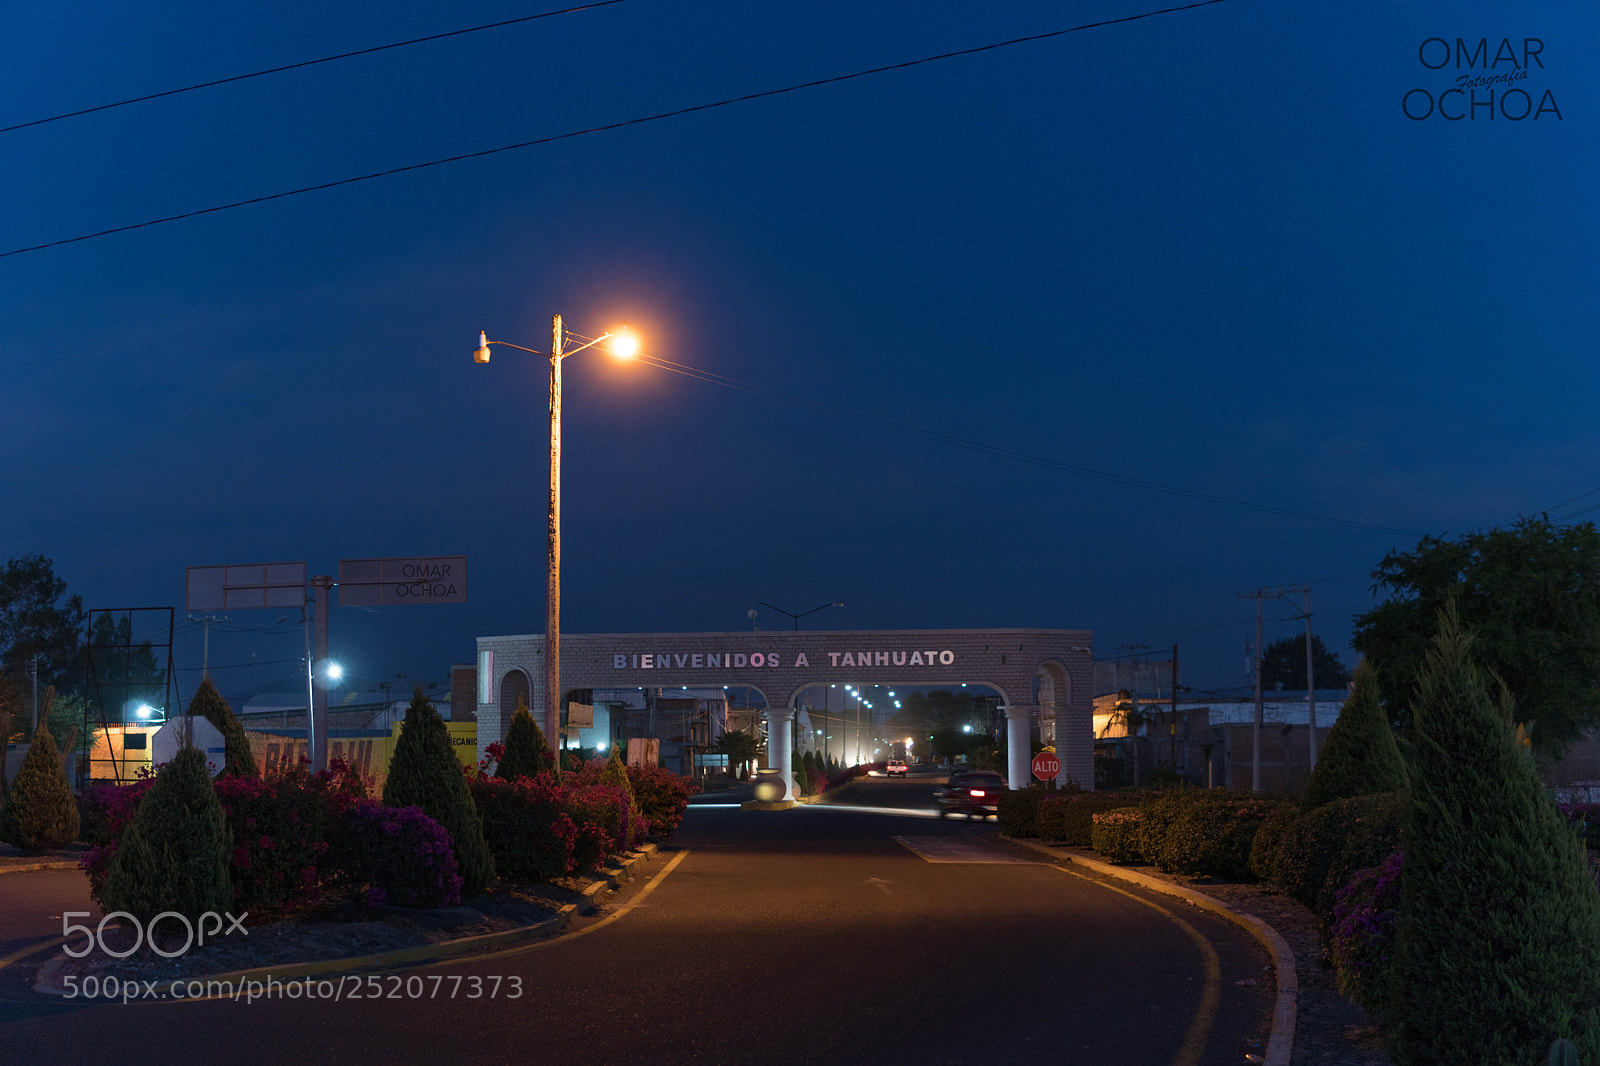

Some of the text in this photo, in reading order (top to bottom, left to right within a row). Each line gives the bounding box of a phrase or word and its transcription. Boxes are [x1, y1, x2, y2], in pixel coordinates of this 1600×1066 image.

[613, 649, 955, 670] BIENVENIDOS A TANHUATO
[1034, 761, 1059, 772] ALTO
